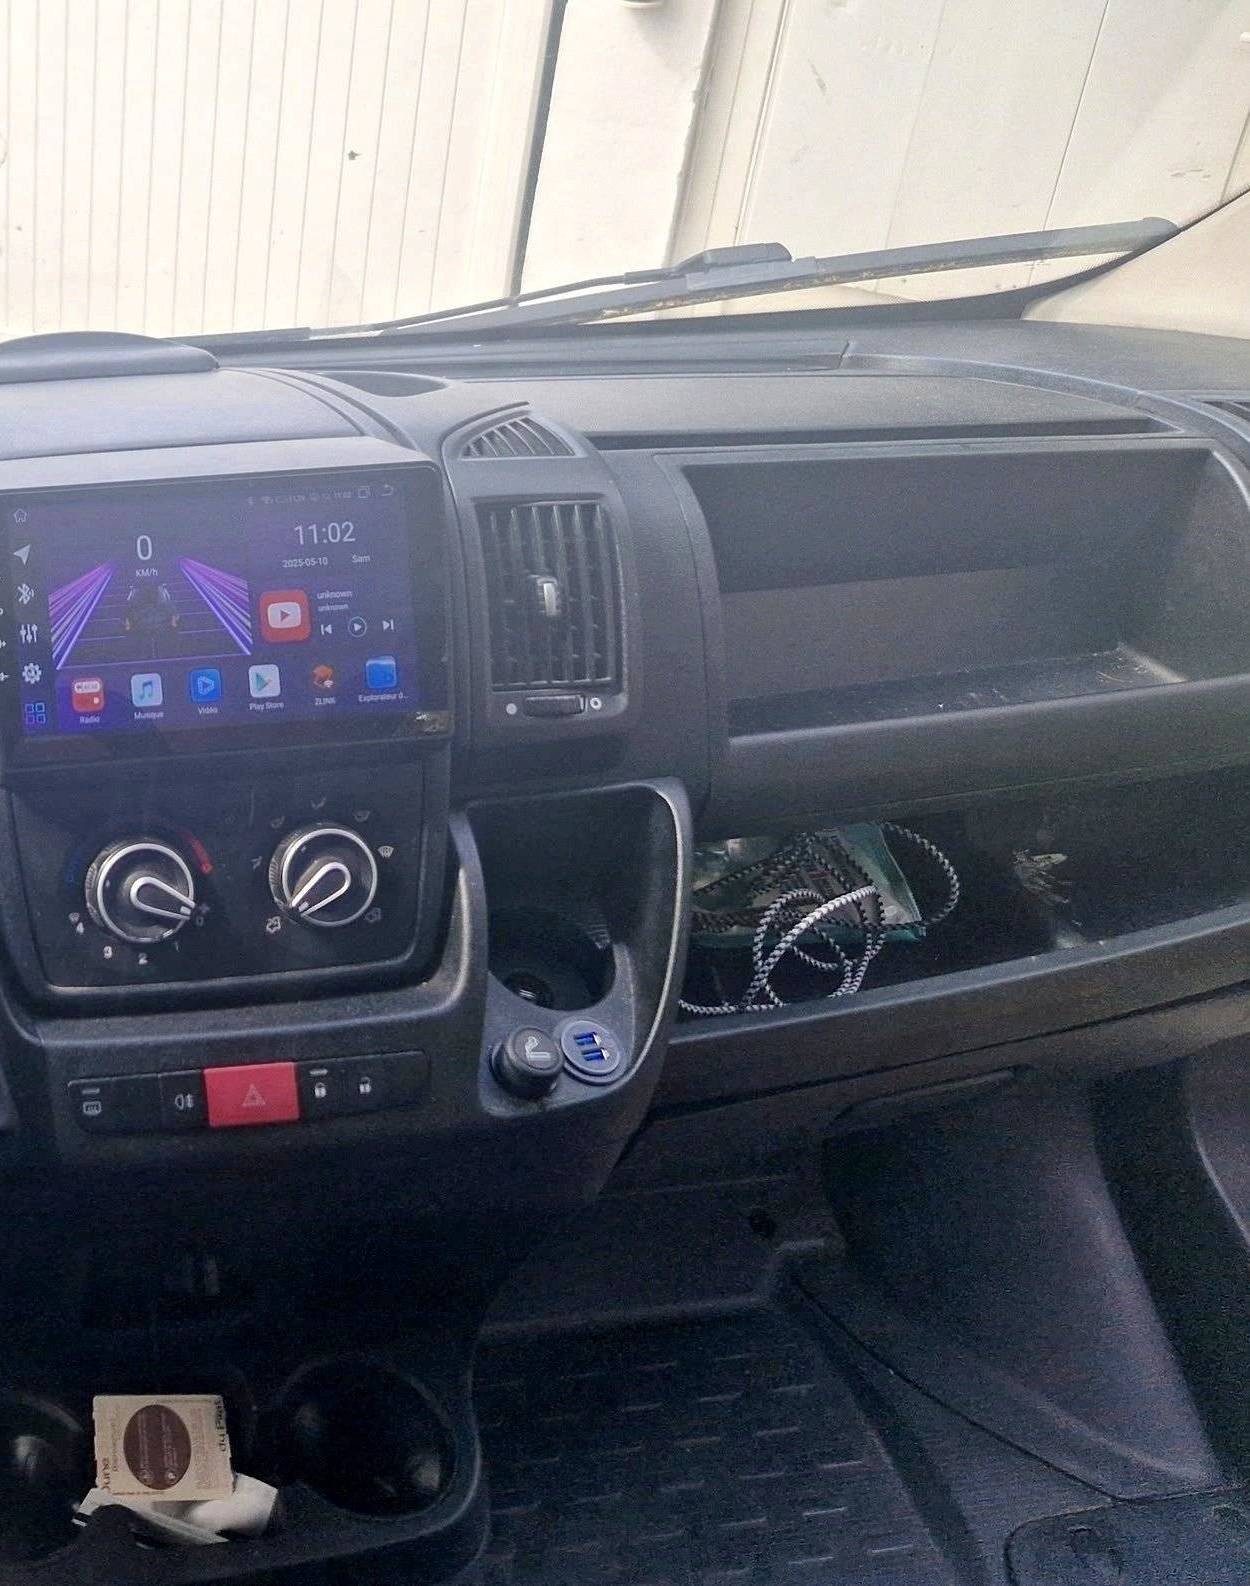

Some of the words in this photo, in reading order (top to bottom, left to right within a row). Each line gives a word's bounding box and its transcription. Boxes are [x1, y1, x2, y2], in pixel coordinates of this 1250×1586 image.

[294, 521, 356, 545] 11:02
[136, 535, 153, 560] 0
[282, 557, 329, 568] 2025-05-10
[352, 554, 371, 563] Sam
[135, 567, 158, 577] KM/h
[316, 590, 352, 600] unknown
[317, 603, 349, 612] unknown
[314, 696, 337, 706] ZLINK
[249, 702, 264, 712] Play
[266, 701, 285, 710] Store
[79, 715, 101, 724] Radio
[134, 711, 164, 721] Musique
[76, 922, 84, 934] 4
